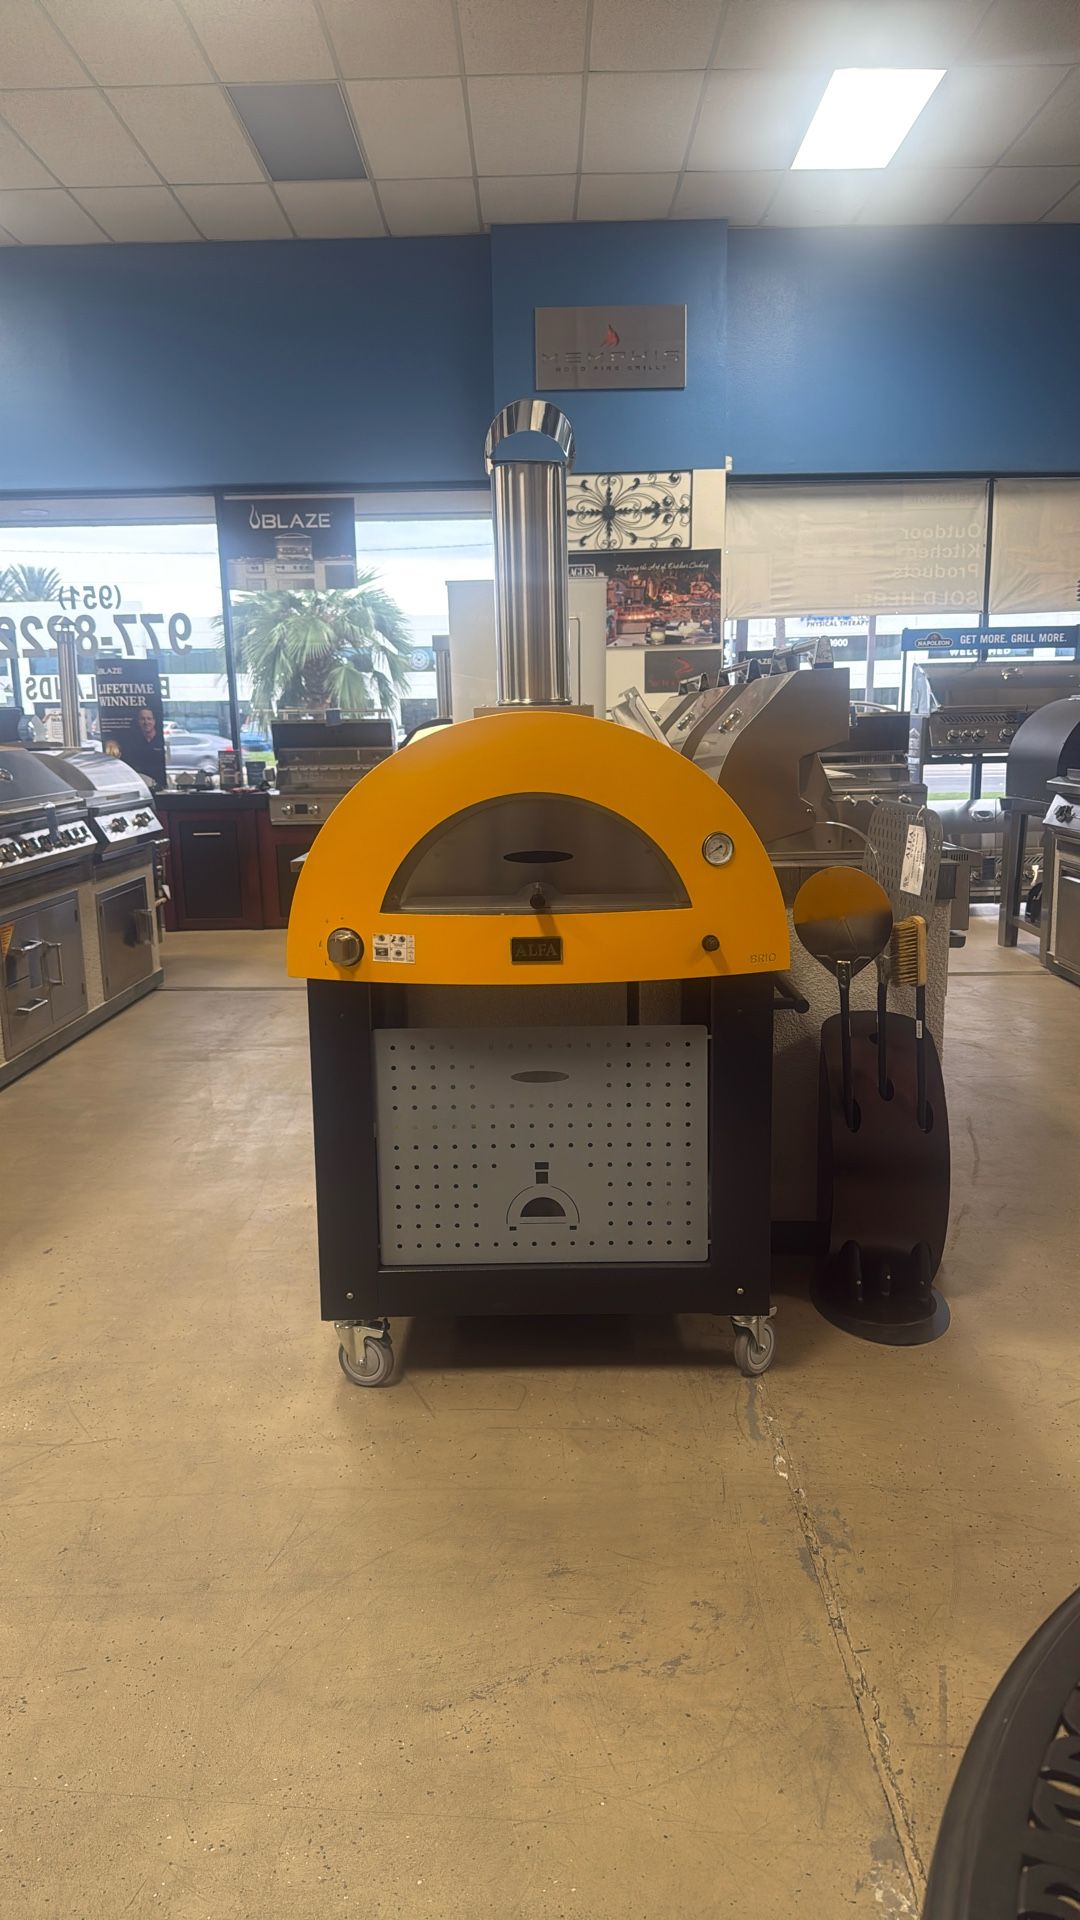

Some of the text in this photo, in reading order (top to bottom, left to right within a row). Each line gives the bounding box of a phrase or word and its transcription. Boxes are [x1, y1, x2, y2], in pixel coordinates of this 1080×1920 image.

[261, 513, 332, 529] BLAZE
[806, 620, 837, 628] PHYSICAL
[917, 633, 1067, 647] NAPOLEON GET MORE. GRILL MORE.
[98, 683, 155, 695] LIFETIME
[99, 695, 148, 707] WINNER
[514, 943, 559, 957] ALFA
[750, 952, 777, 963] BRIO
